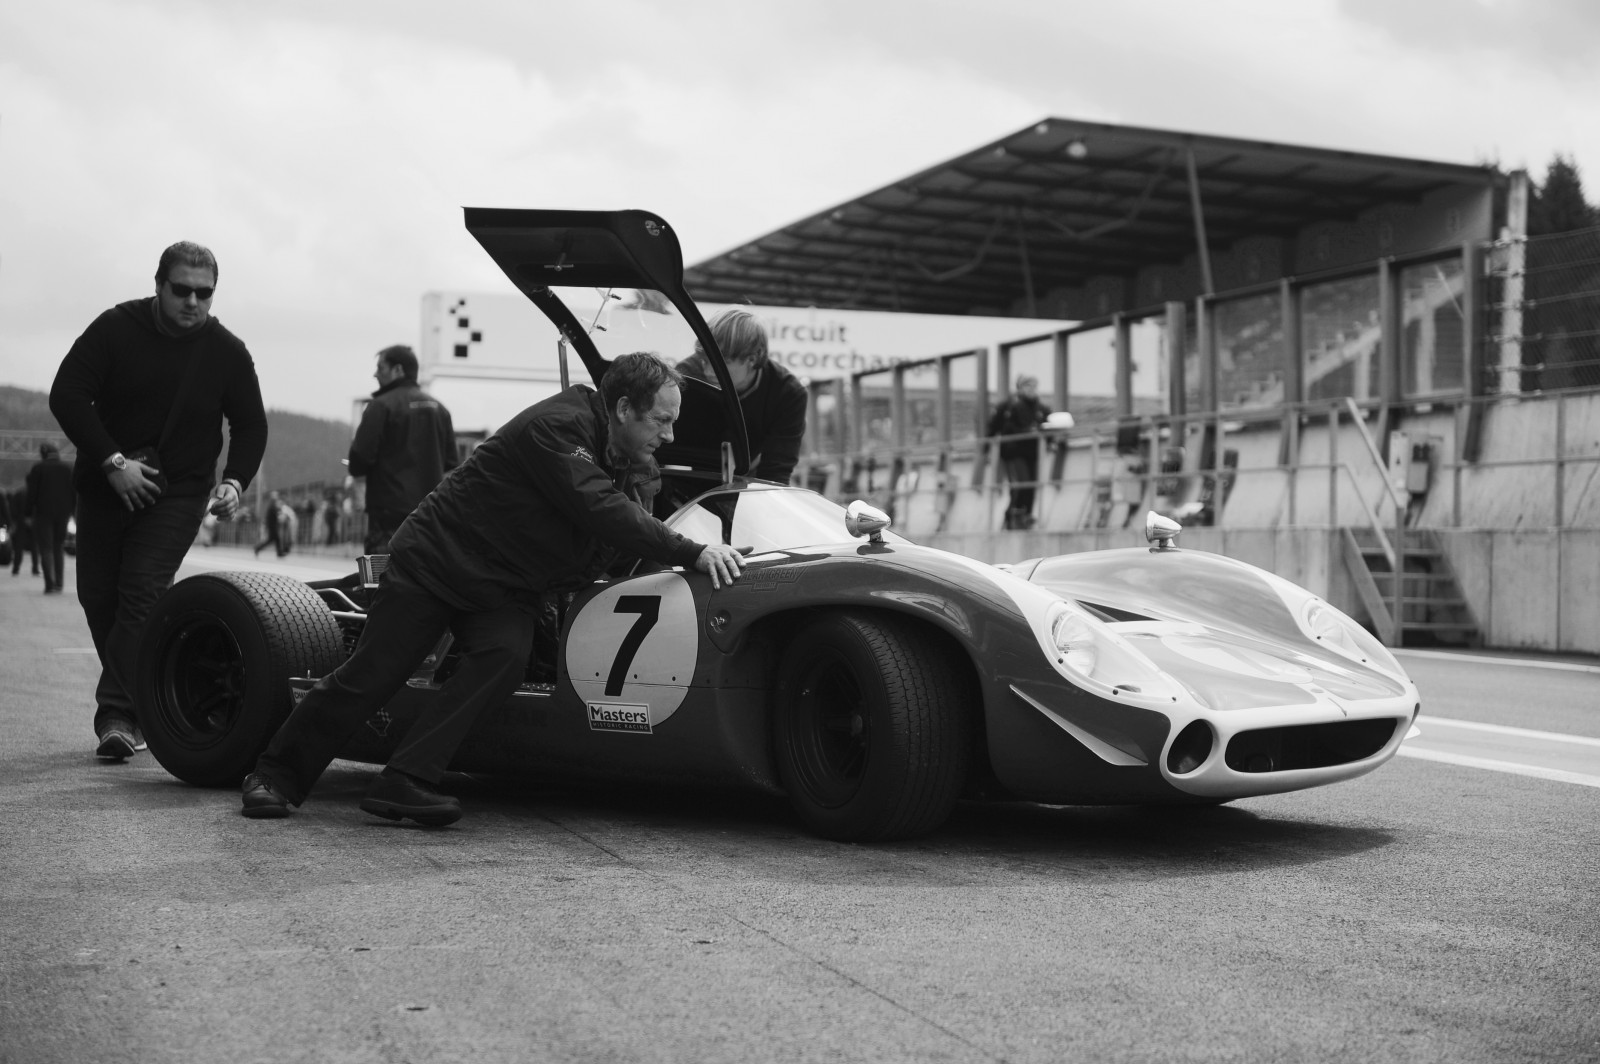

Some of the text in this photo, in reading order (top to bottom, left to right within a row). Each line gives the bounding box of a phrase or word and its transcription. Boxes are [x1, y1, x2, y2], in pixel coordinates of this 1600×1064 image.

[770, 320, 847, 343] ircuit
[604, 595, 662, 697] 7
[590, 705, 647, 723] Masters
[592, 721, 622, 729] HISTORIC
